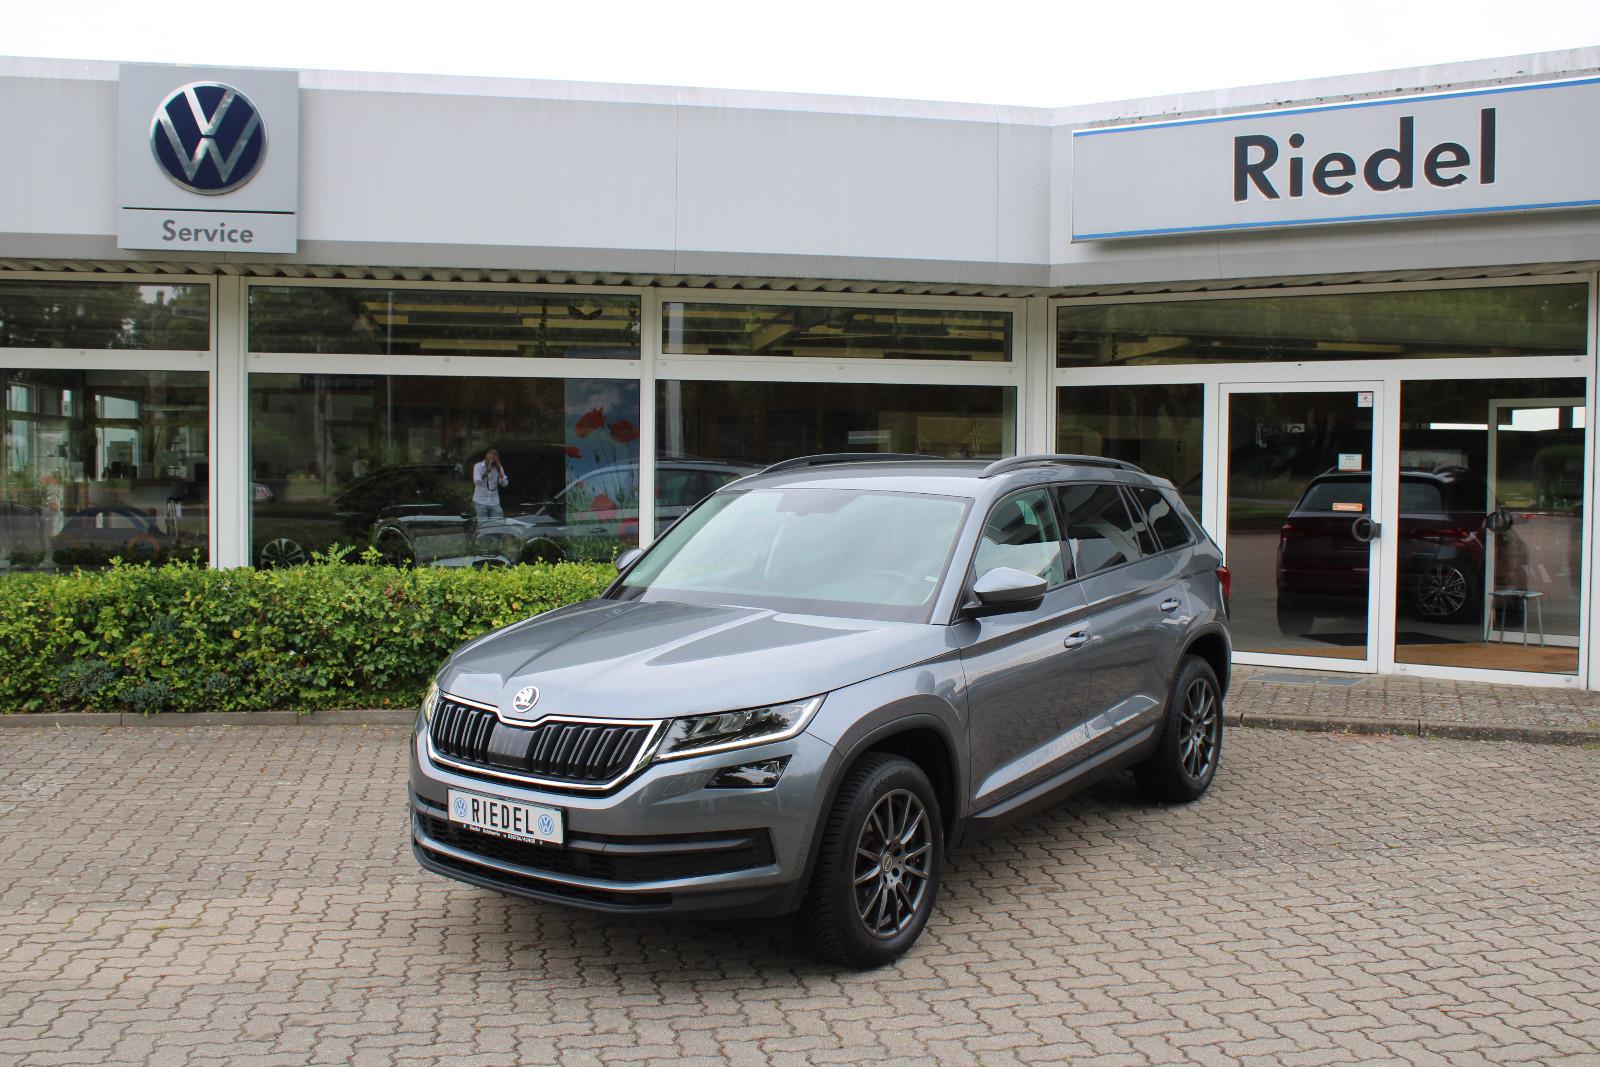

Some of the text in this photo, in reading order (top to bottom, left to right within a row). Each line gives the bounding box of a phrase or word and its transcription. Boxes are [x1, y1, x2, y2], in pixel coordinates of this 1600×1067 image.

[154, 84, 264, 190] VW
[1234, 107, 1496, 202] Riedel
[162, 219, 253, 244] Service
[471, 797, 535, 835] RIEDEL
